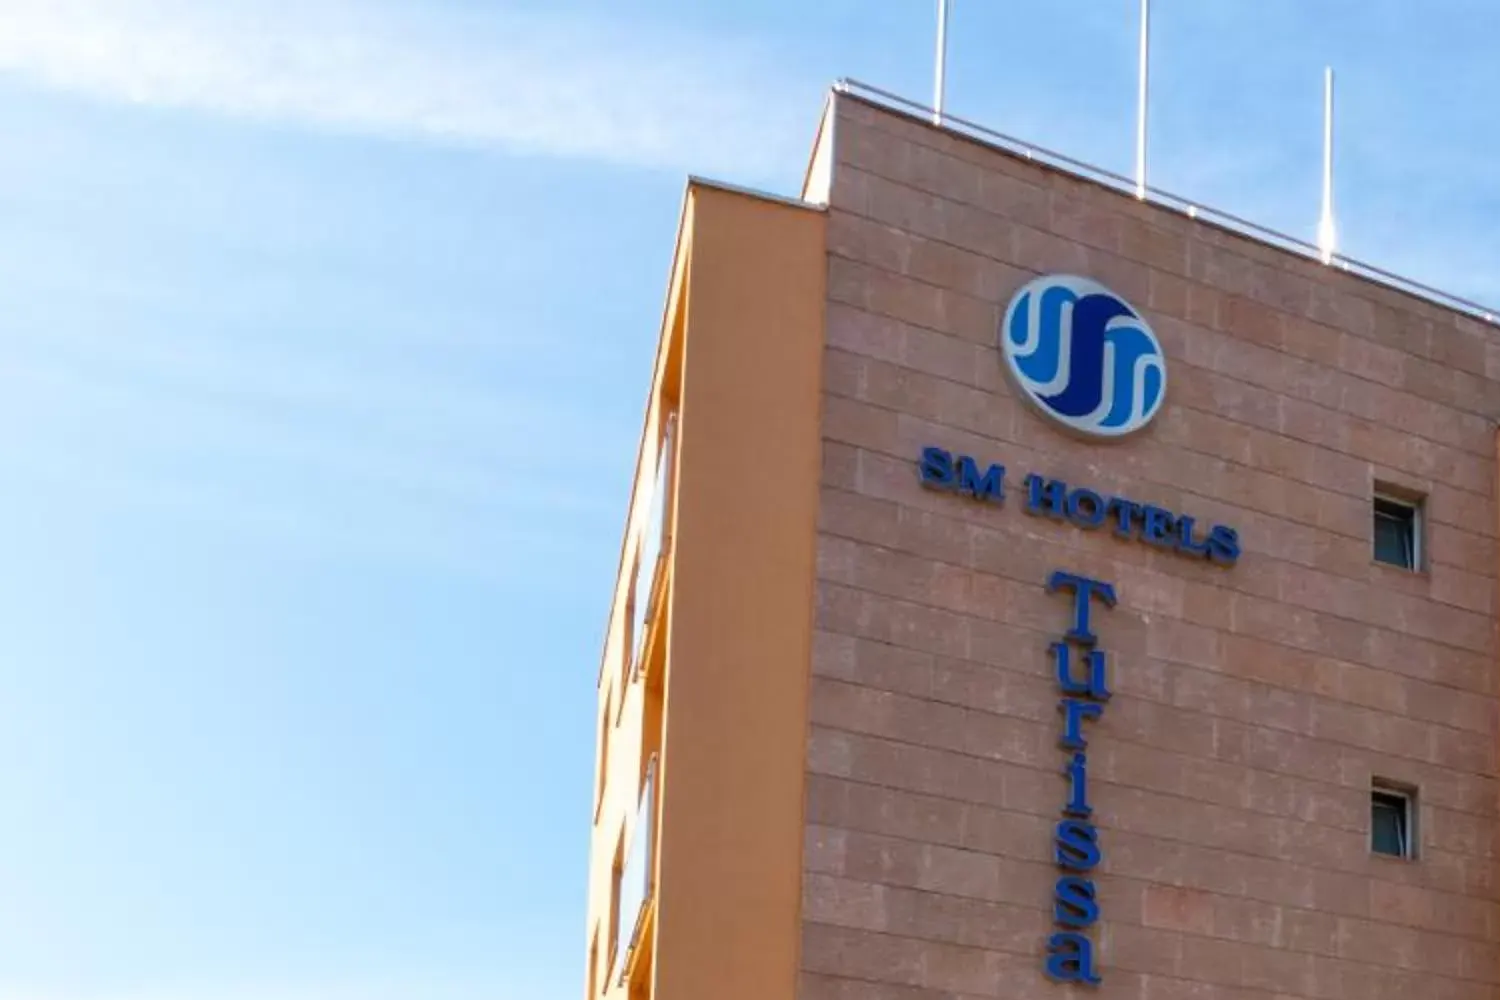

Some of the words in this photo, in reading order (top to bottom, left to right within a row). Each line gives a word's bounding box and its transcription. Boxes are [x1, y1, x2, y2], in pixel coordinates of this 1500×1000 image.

[919, 446, 1005, 502] SM
[1024, 472, 1241, 564] HOTELS
[1044, 570, 1117, 986] Turissa
